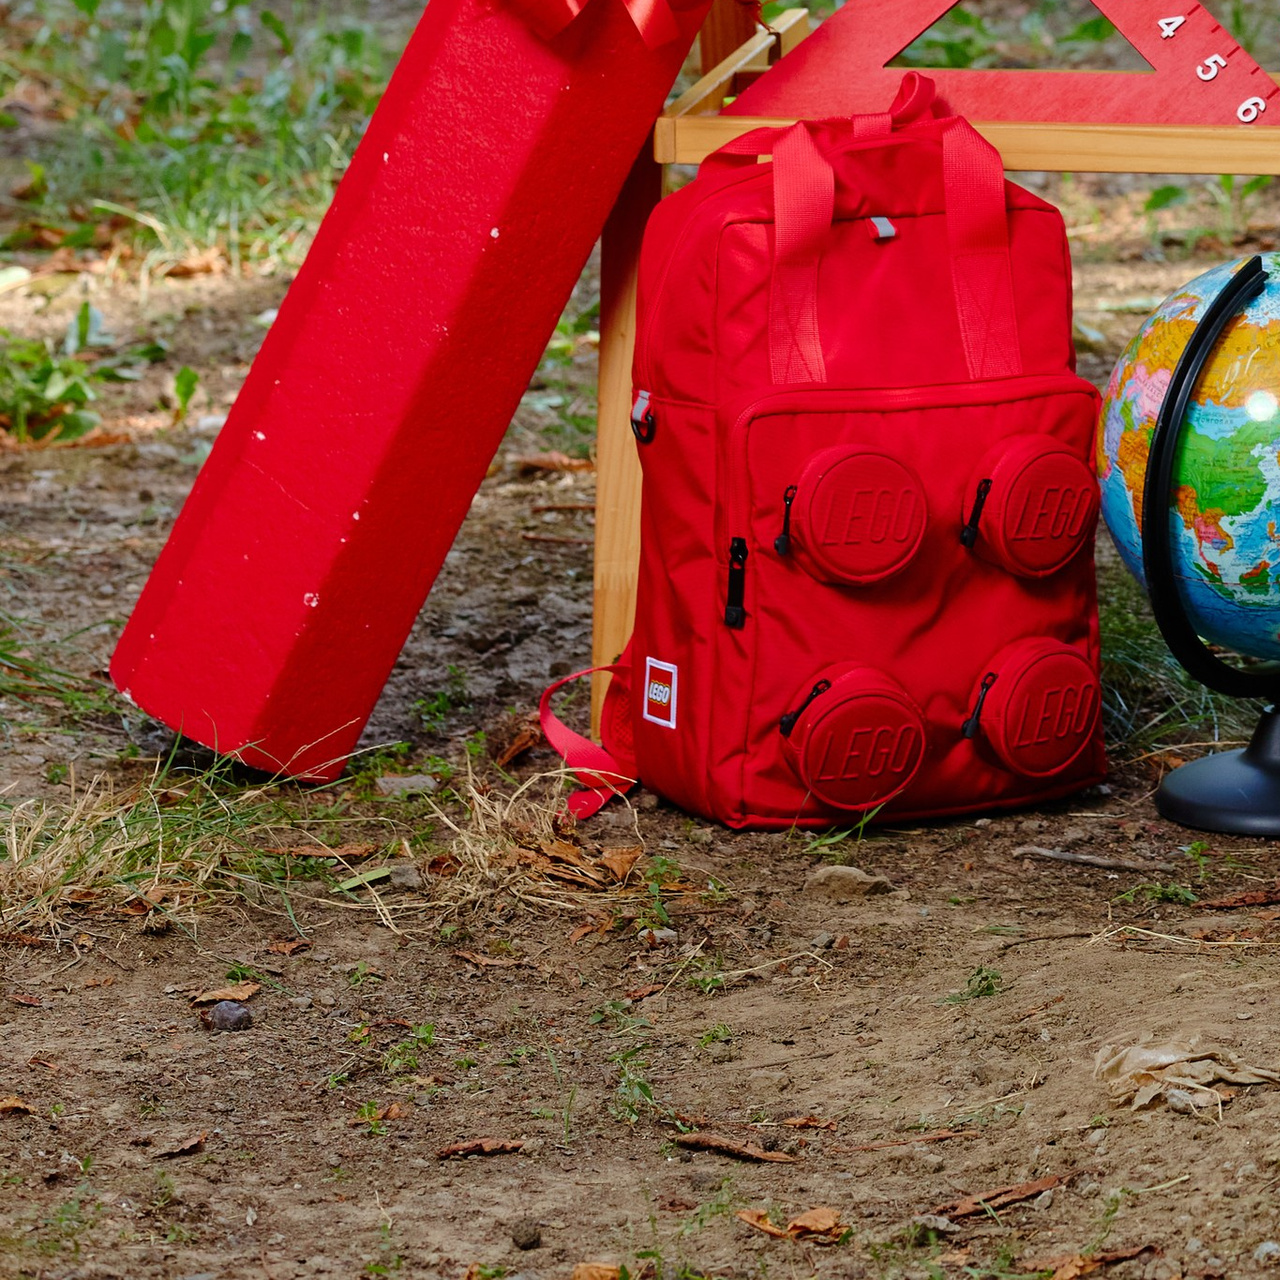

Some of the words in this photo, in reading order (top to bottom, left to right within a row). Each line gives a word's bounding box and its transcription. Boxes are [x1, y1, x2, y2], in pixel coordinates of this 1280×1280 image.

[1157, 14, 1186, 39] 4
[1196, 53, 1228, 82] 5
[1236, 94, 1267, 123] 6
[822, 488, 917, 547] LEGO
[1011, 483, 1093, 541] LEGO
[648, 679, 671, 706] LEGO
[1013, 683, 1095, 749] LEGO
[815, 725, 918, 782] LEGO
